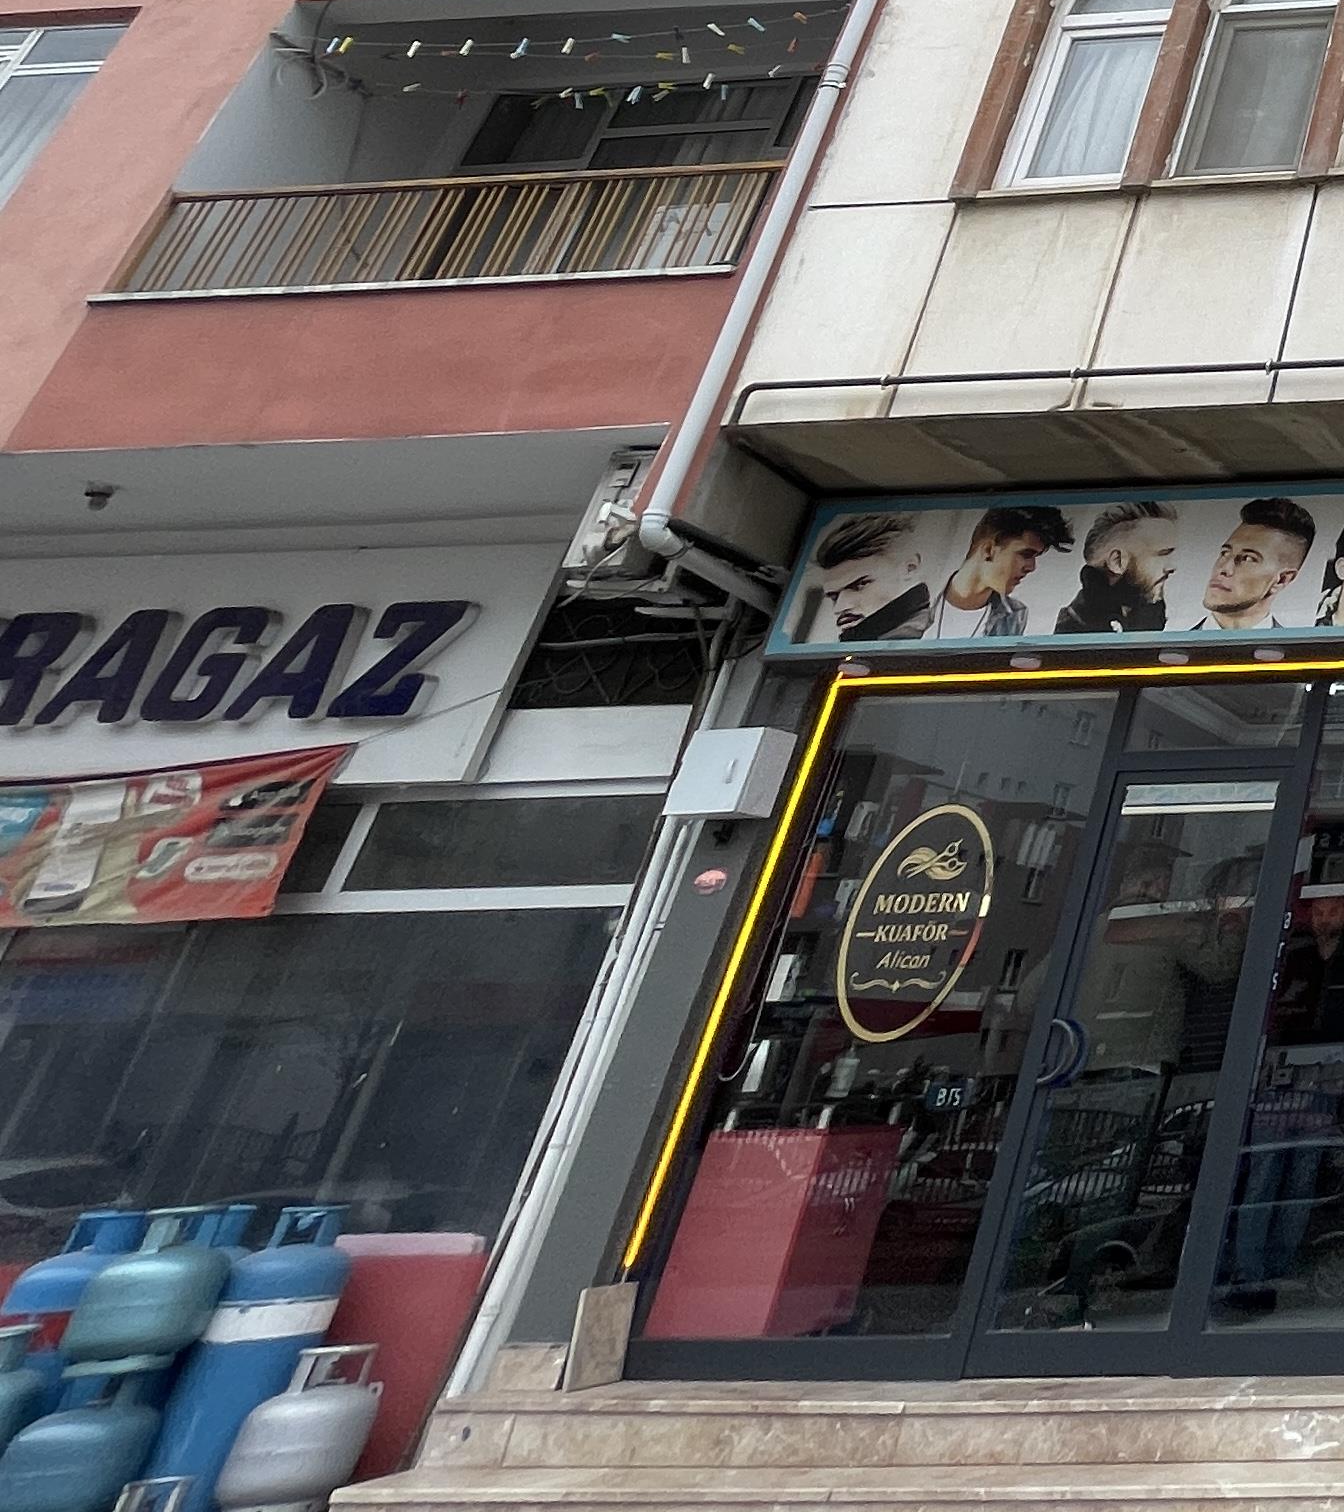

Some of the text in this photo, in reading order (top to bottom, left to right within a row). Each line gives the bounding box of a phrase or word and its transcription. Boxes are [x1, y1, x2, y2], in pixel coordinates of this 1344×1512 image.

[0, 599, 476, 727] RAGAZ
[873, 891, 972, 915] MODERN
[873, 921, 949, 943] KUAFÖR
[876, 950, 931, 970] Alican
